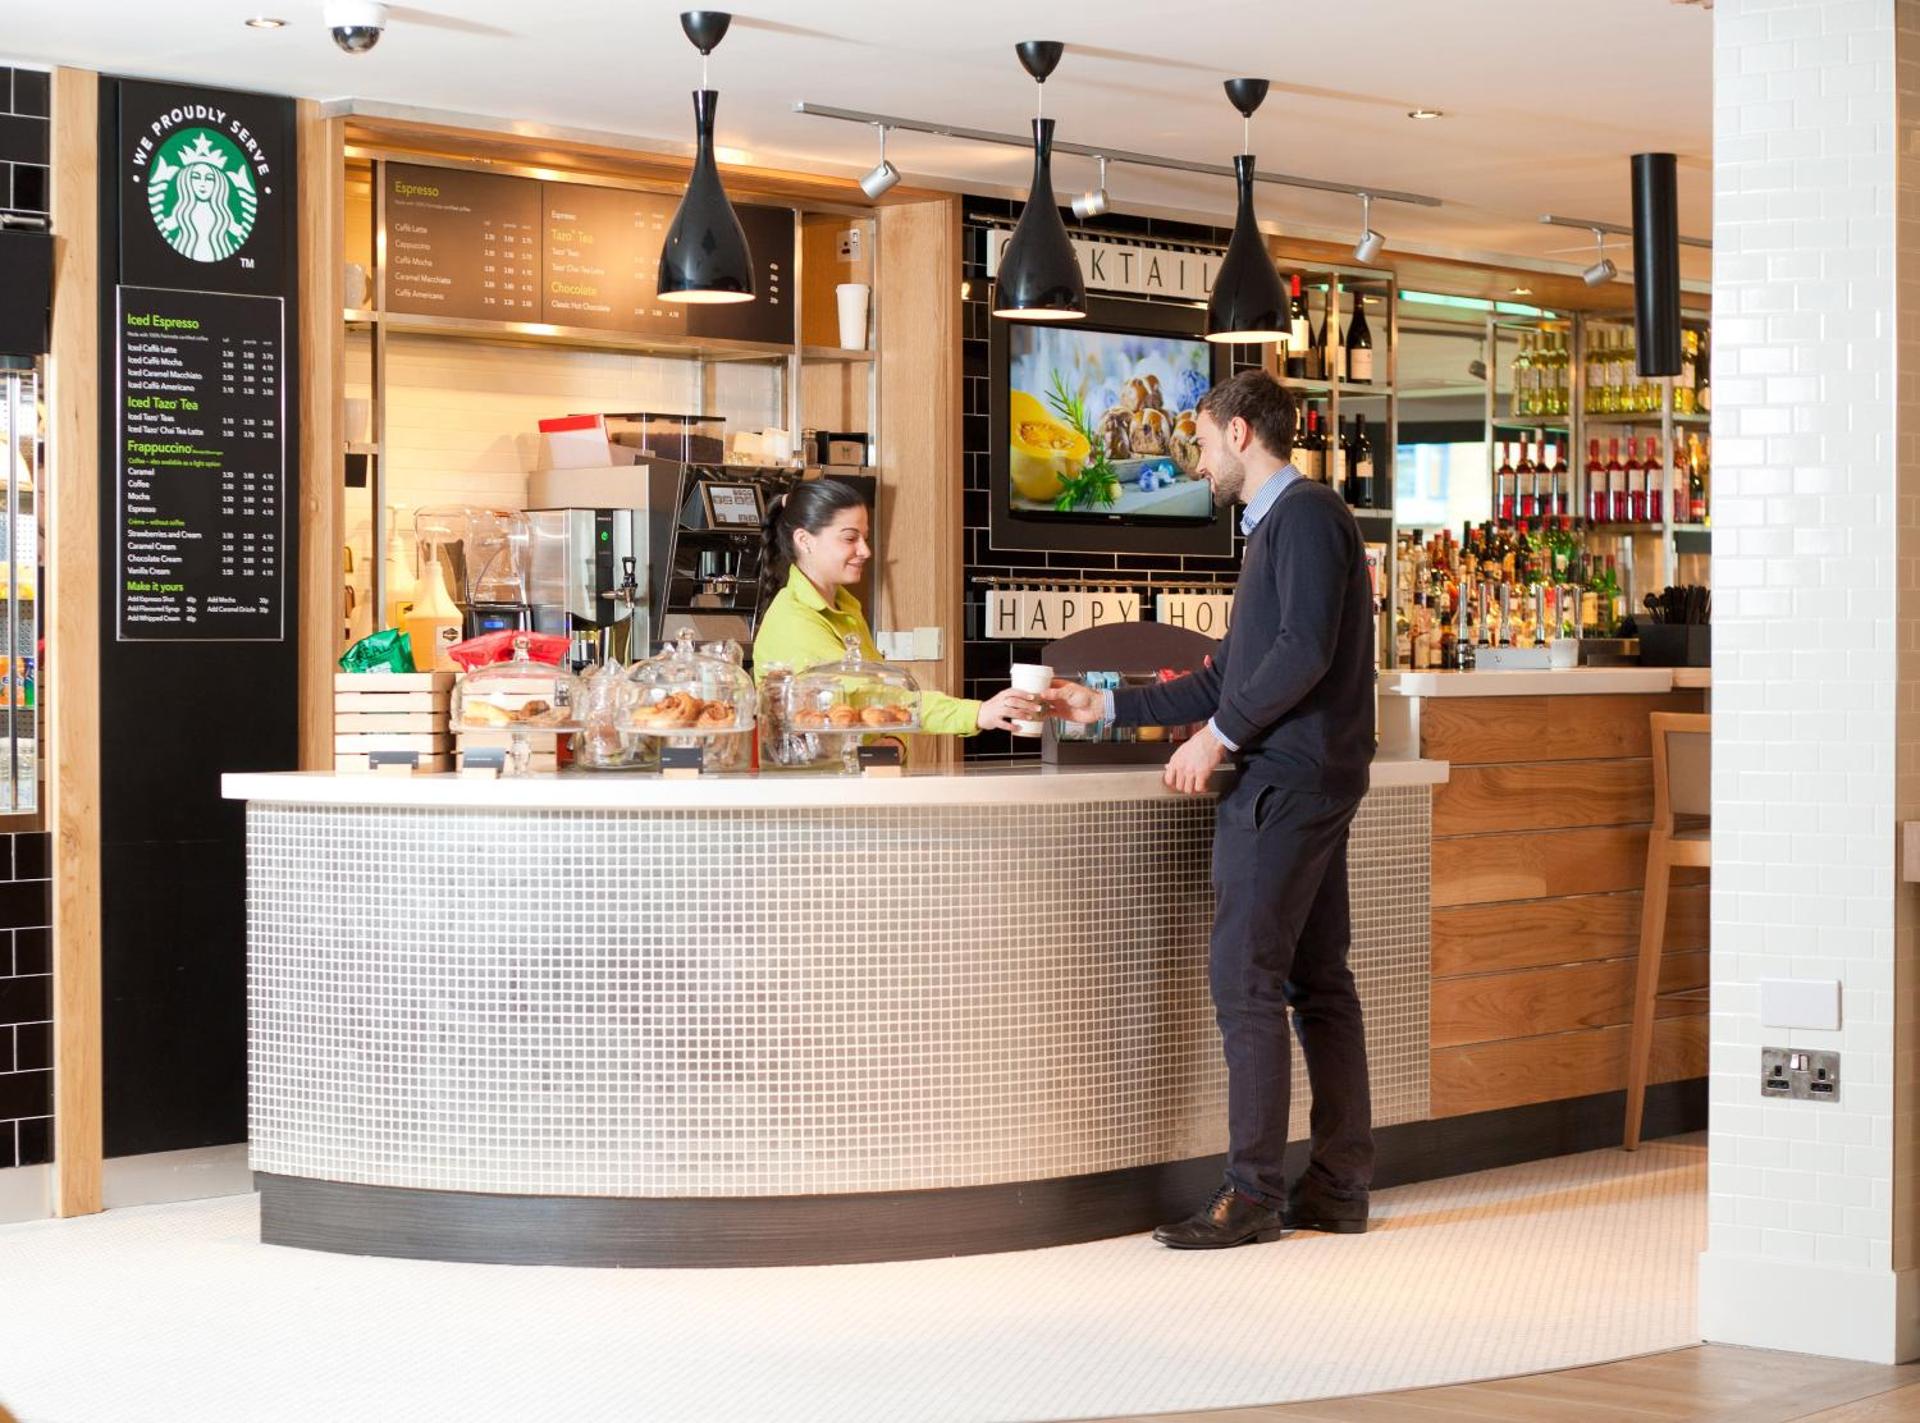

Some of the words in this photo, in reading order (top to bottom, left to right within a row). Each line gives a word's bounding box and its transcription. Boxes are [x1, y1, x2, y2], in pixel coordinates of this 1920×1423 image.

[133, 136, 153, 166] WE
[152, 105, 227, 136] PROUDLY
[230, 120, 270, 175] SERVE
[395, 181, 439, 197] Espresso
[240, 258, 254, 268] TM
[127, 313, 149, 326] Iced
[153, 315, 199, 330] Espresso
[128, 396, 150, 408] Iced
[180, 398, 198, 410] Tea
[128, 480, 150, 488] Coffee
[182, 531, 201, 539] Cream
[128, 542, 154, 550] Caramel
[155, 543, 176, 551] Cream
[128, 567, 149, 575] Vanilla
[128, 582, 150, 591] Make
[152, 583, 158, 591] it
[160, 584, 184, 593] yours
[1000, 598, 1133, 631] HAPPY
